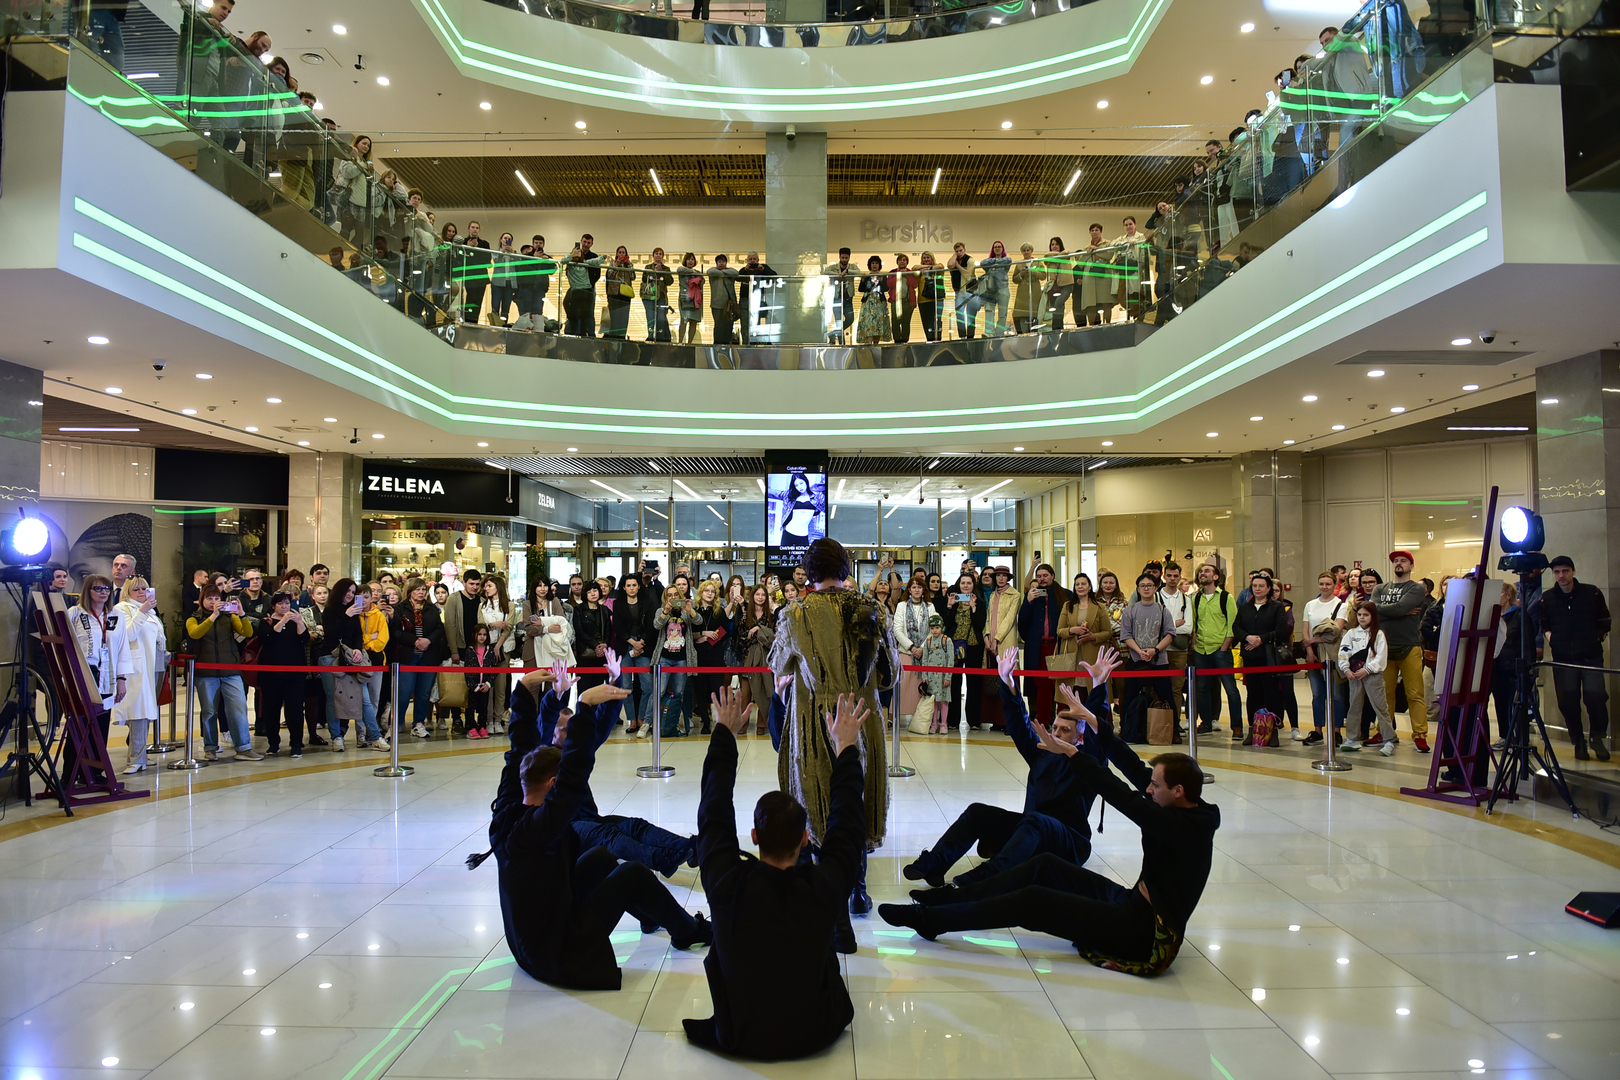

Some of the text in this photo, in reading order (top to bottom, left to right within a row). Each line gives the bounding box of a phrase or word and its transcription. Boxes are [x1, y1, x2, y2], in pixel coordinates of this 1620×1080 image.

[860, 219, 953, 243] Bershka
[367, 475, 445, 495] ZELENA
[538, 492, 556, 509] ZELENA
